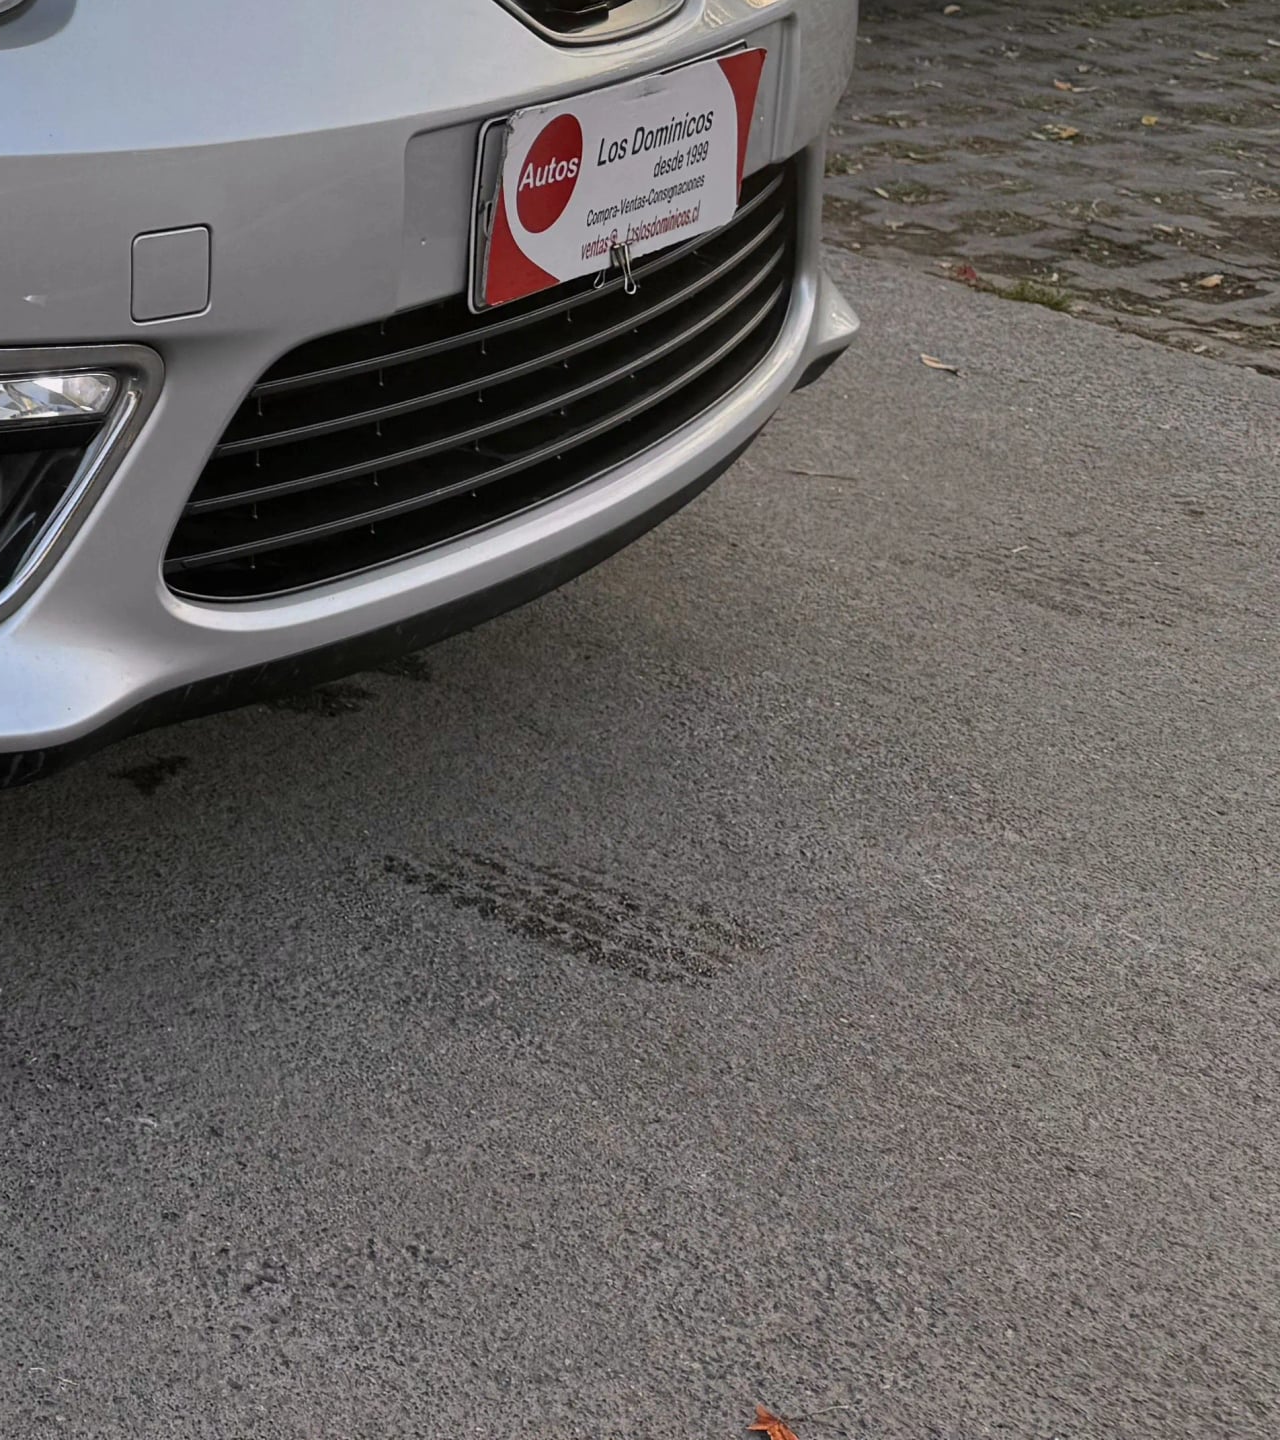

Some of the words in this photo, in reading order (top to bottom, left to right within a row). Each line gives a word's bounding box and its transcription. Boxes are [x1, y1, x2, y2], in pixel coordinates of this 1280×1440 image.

[597, 138, 628, 166] Los
[632, 110, 714, 155] Dominicos
[518, 157, 579, 191] Autos
[653, 150, 684, 178] desde
[686, 141, 709, 167] 1999
